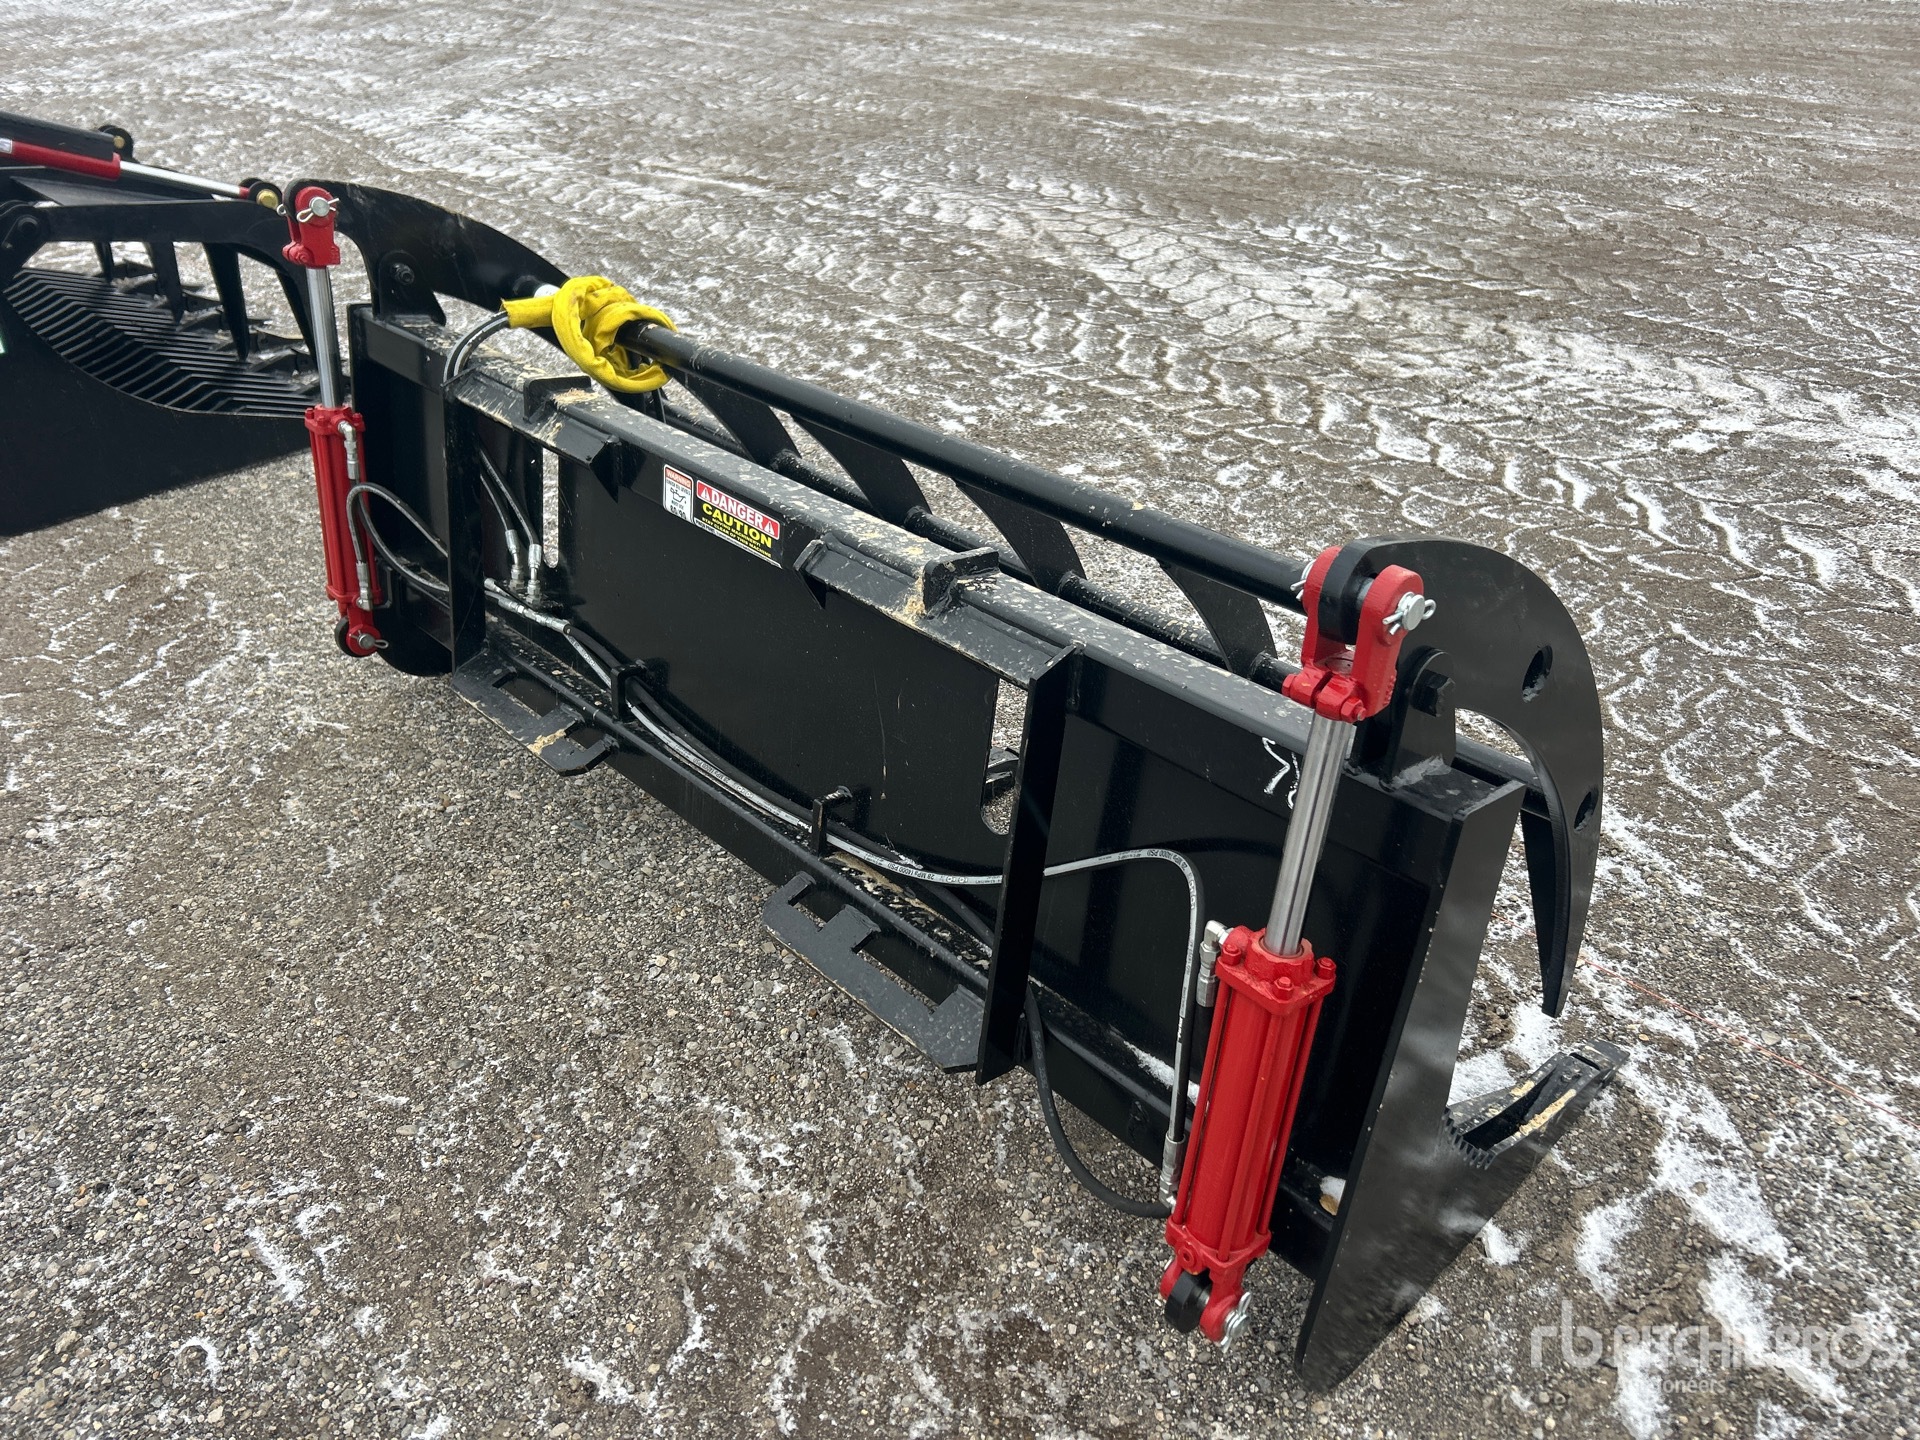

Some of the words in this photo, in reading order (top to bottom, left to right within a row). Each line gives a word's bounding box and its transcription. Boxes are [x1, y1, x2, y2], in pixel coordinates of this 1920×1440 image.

[702, 503, 772, 549] CAUTION
[711, 489, 764, 530] DANGER
[712, 517, 730, 532] MOVING
[702, 517, 713, 526] STAY
[714, 522, 729, 535] CLEAR
[729, 531, 736, 539] OF
[737, 535, 748, 545] THIS
[748, 541, 772, 559] MACHINE
[913, 870, 925, 879] MPa
